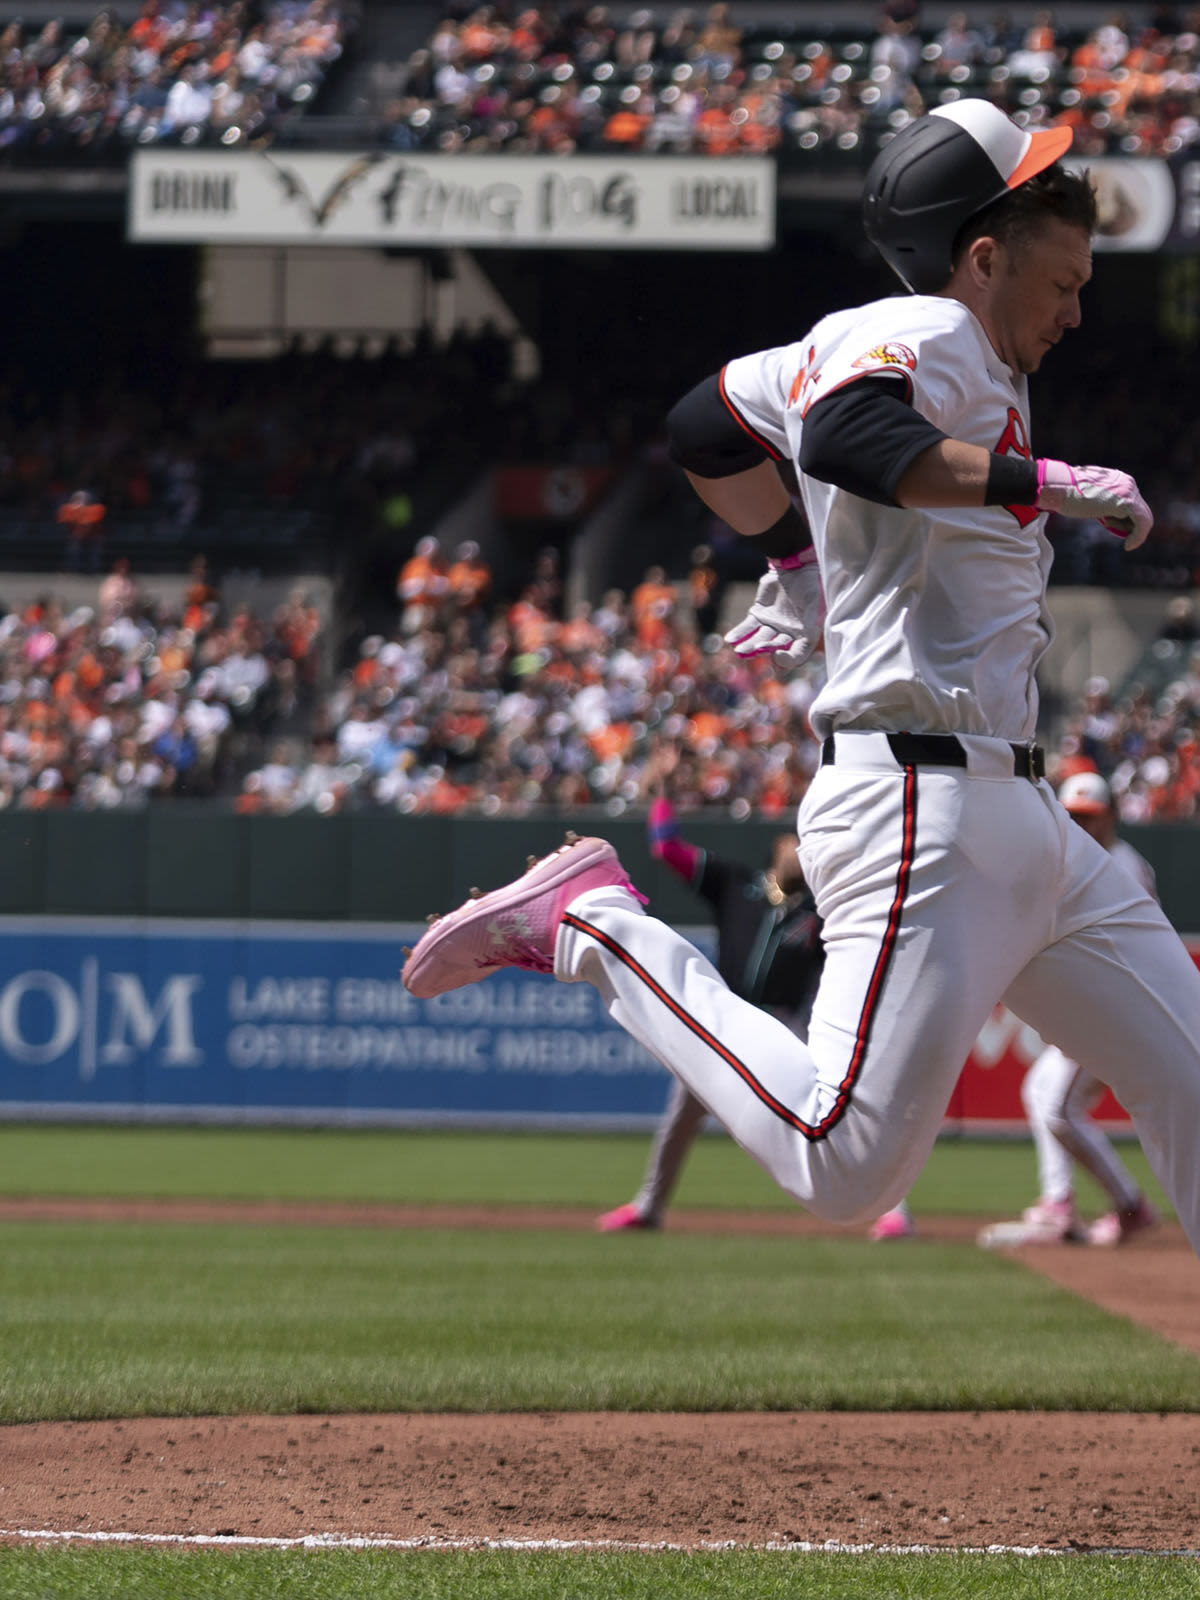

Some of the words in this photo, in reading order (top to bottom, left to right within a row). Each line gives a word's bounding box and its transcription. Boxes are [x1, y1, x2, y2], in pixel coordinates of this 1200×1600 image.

[152, 171, 236, 215] DRINK
[672, 175, 760, 220] LOCAL
[230, 978, 328, 1021] LAKE
[337, 979, 418, 1022] ERIE
[228, 1024, 490, 1071] OSTEOPATHIC
